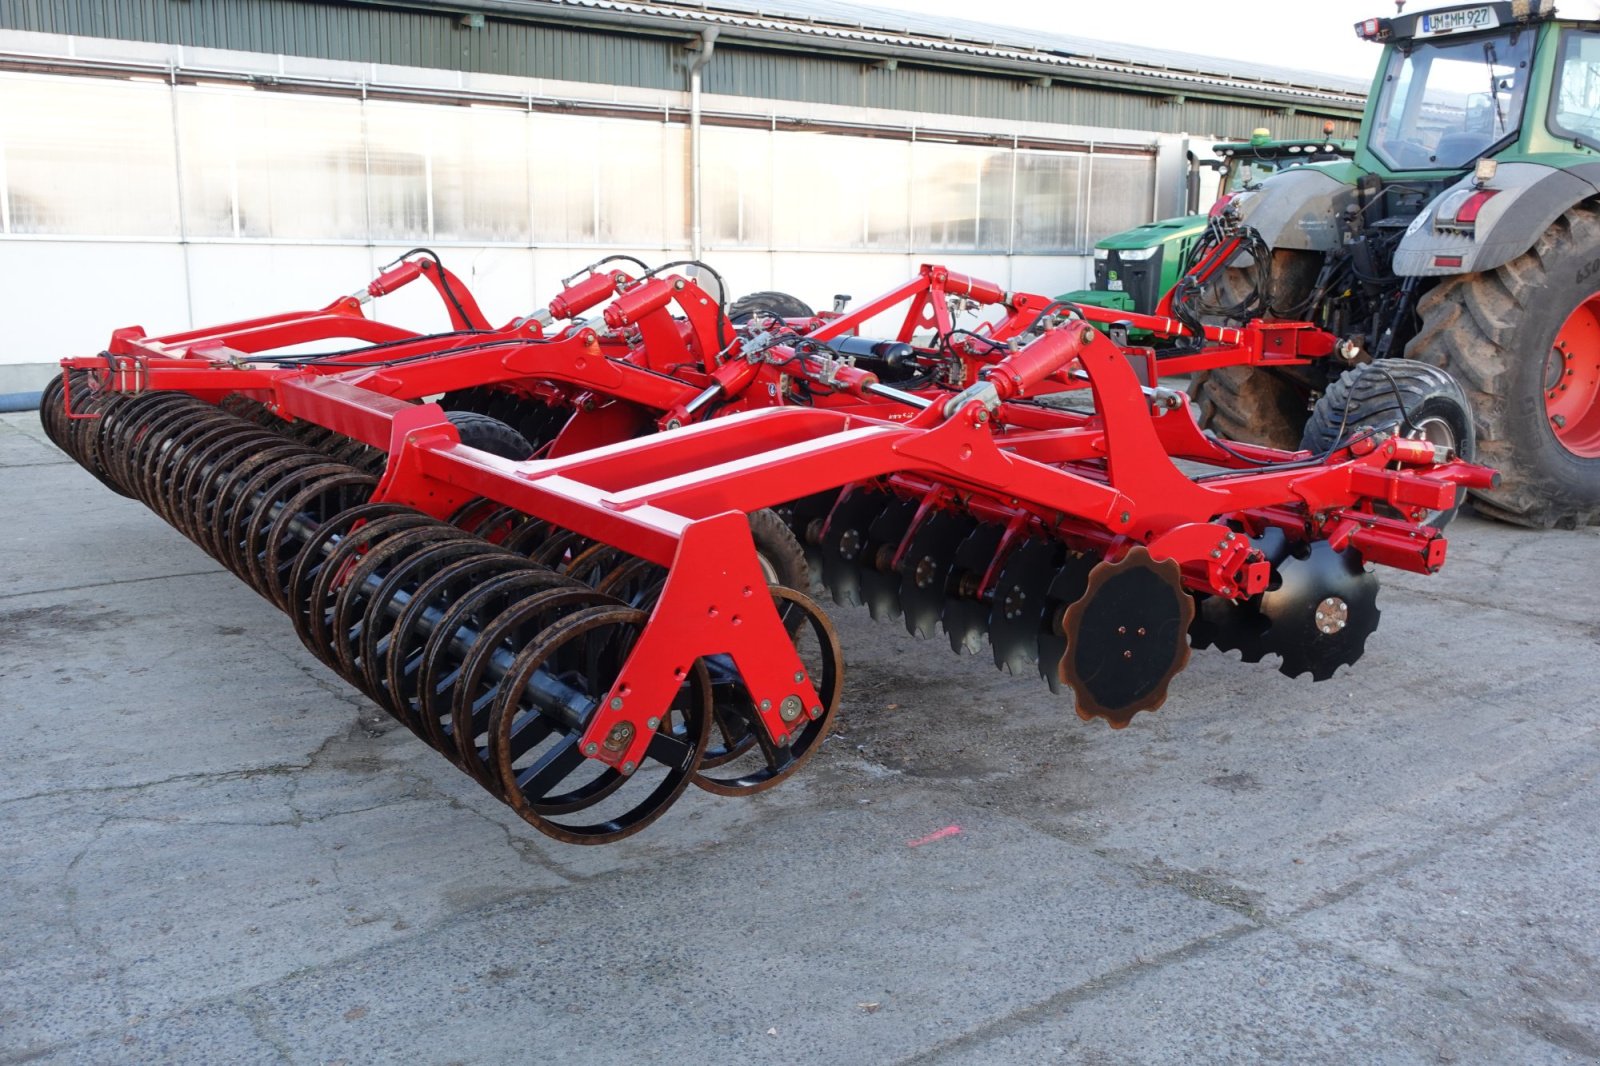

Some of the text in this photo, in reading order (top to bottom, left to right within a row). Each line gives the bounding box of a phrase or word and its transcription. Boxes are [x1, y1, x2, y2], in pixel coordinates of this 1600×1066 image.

[1430, 9, 1488, 29] UM MH 927
